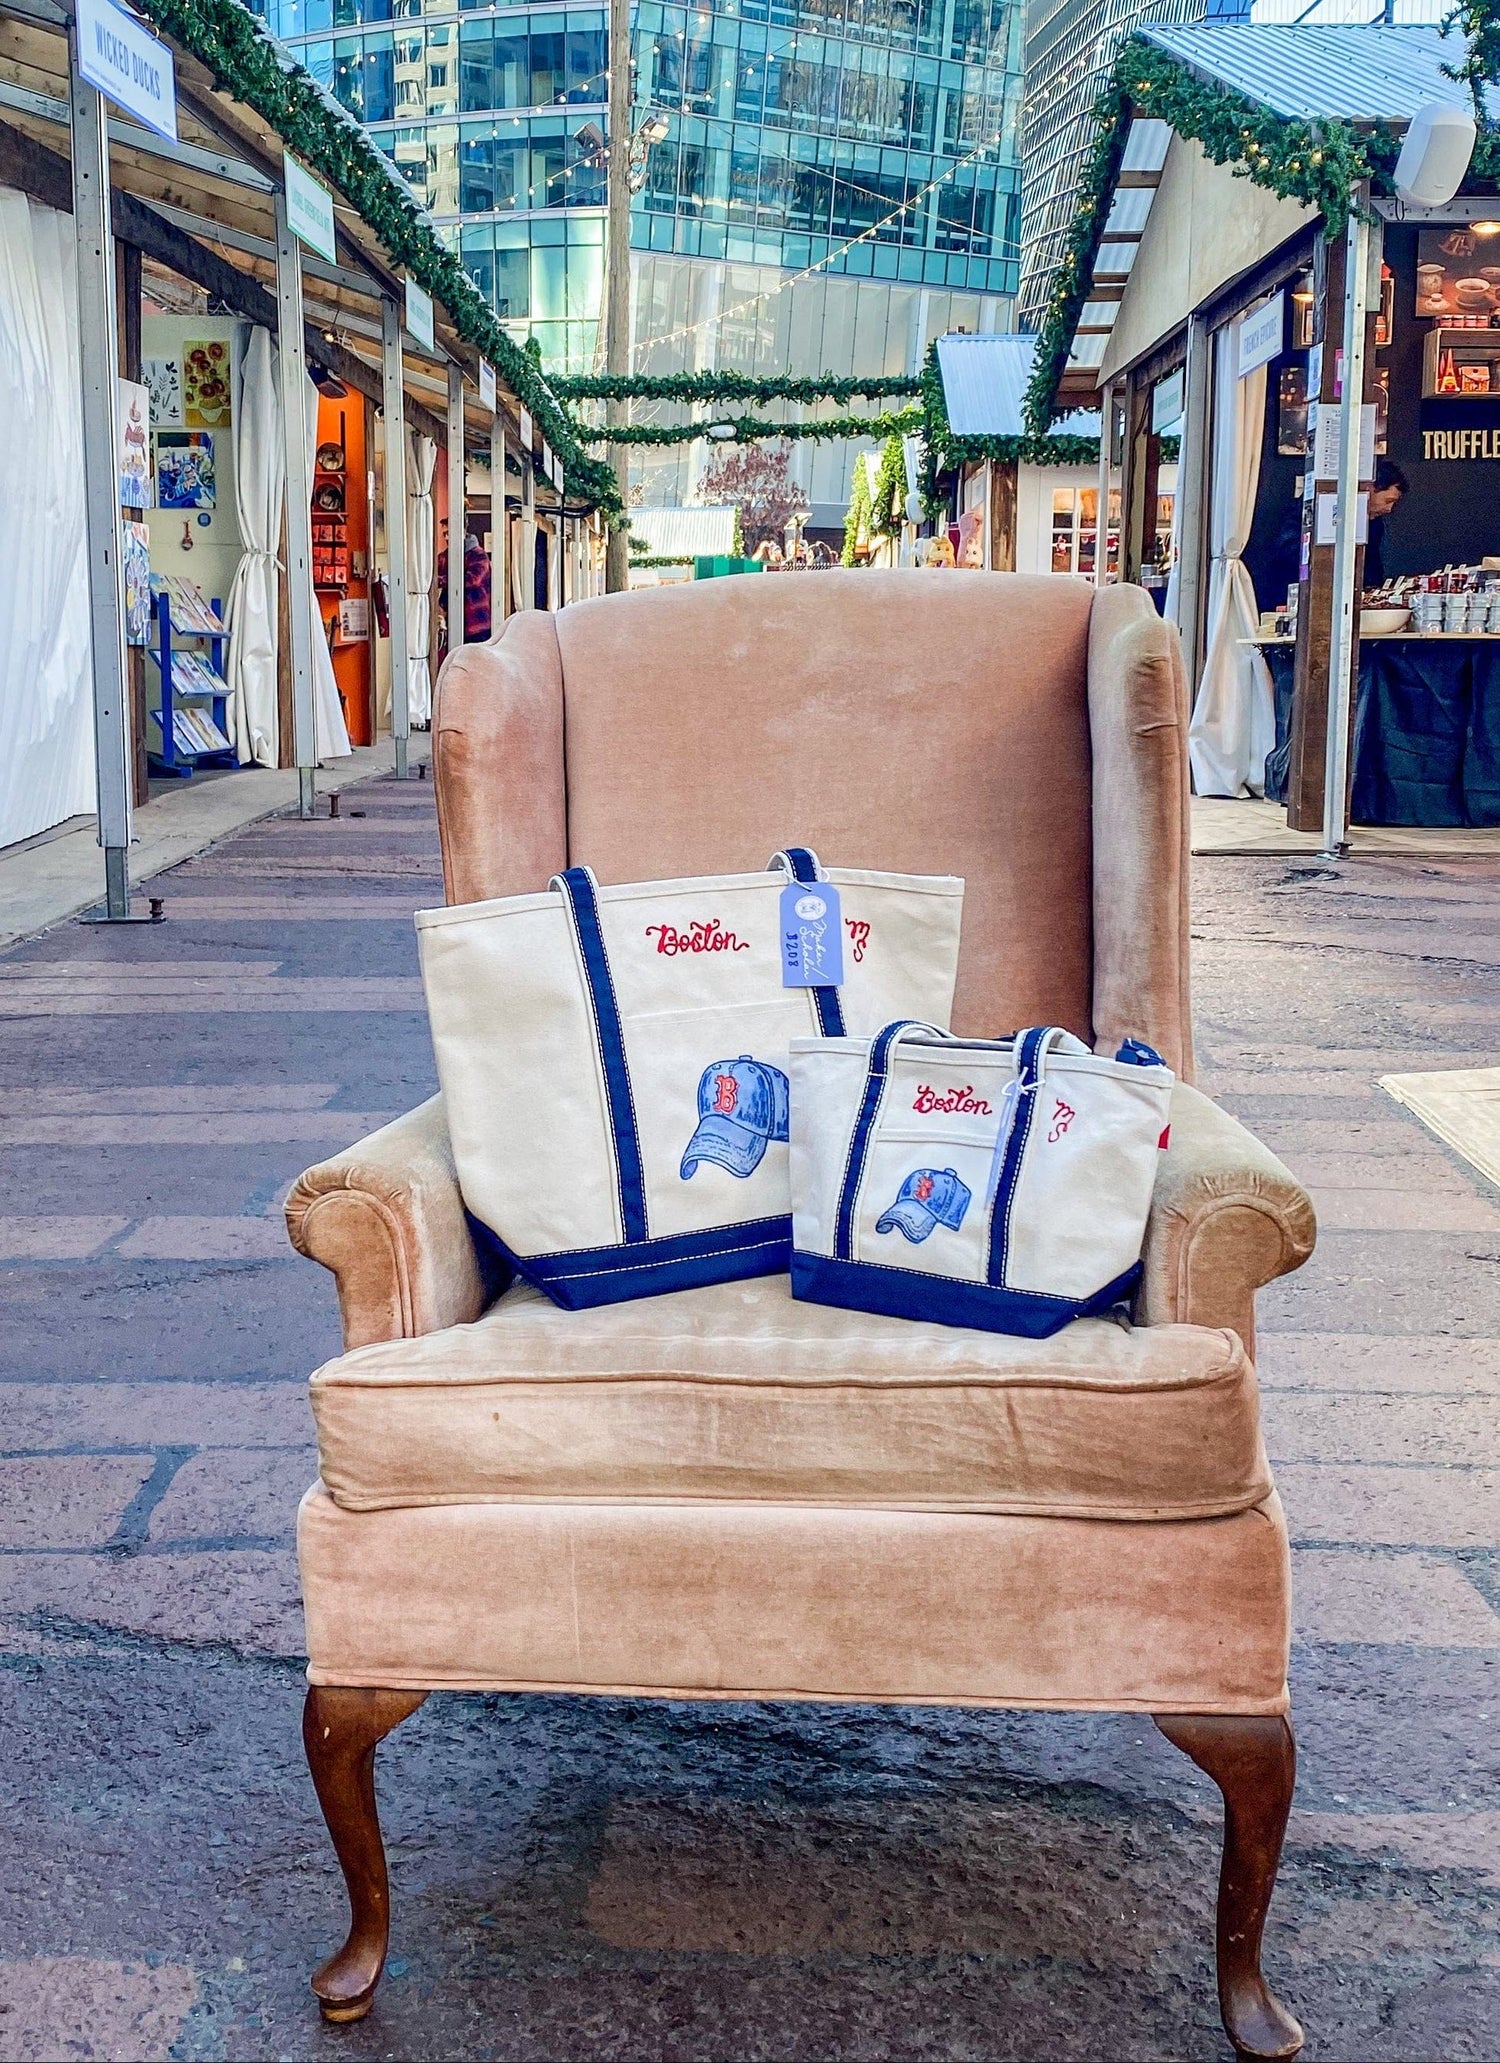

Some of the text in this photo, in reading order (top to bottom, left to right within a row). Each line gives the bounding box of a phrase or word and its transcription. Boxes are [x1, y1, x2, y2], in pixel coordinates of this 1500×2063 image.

[94, 20, 129, 77] WICKED
[132, 52, 161, 101] DUCKS
[1422, 429, 1500, 460] TRUFFLE
[645, 918, 751, 957] Boston
[799, 925, 815, 980] Scholar
[711, 1074, 740, 1115] B
[912, 1085, 993, 1116] Boston
